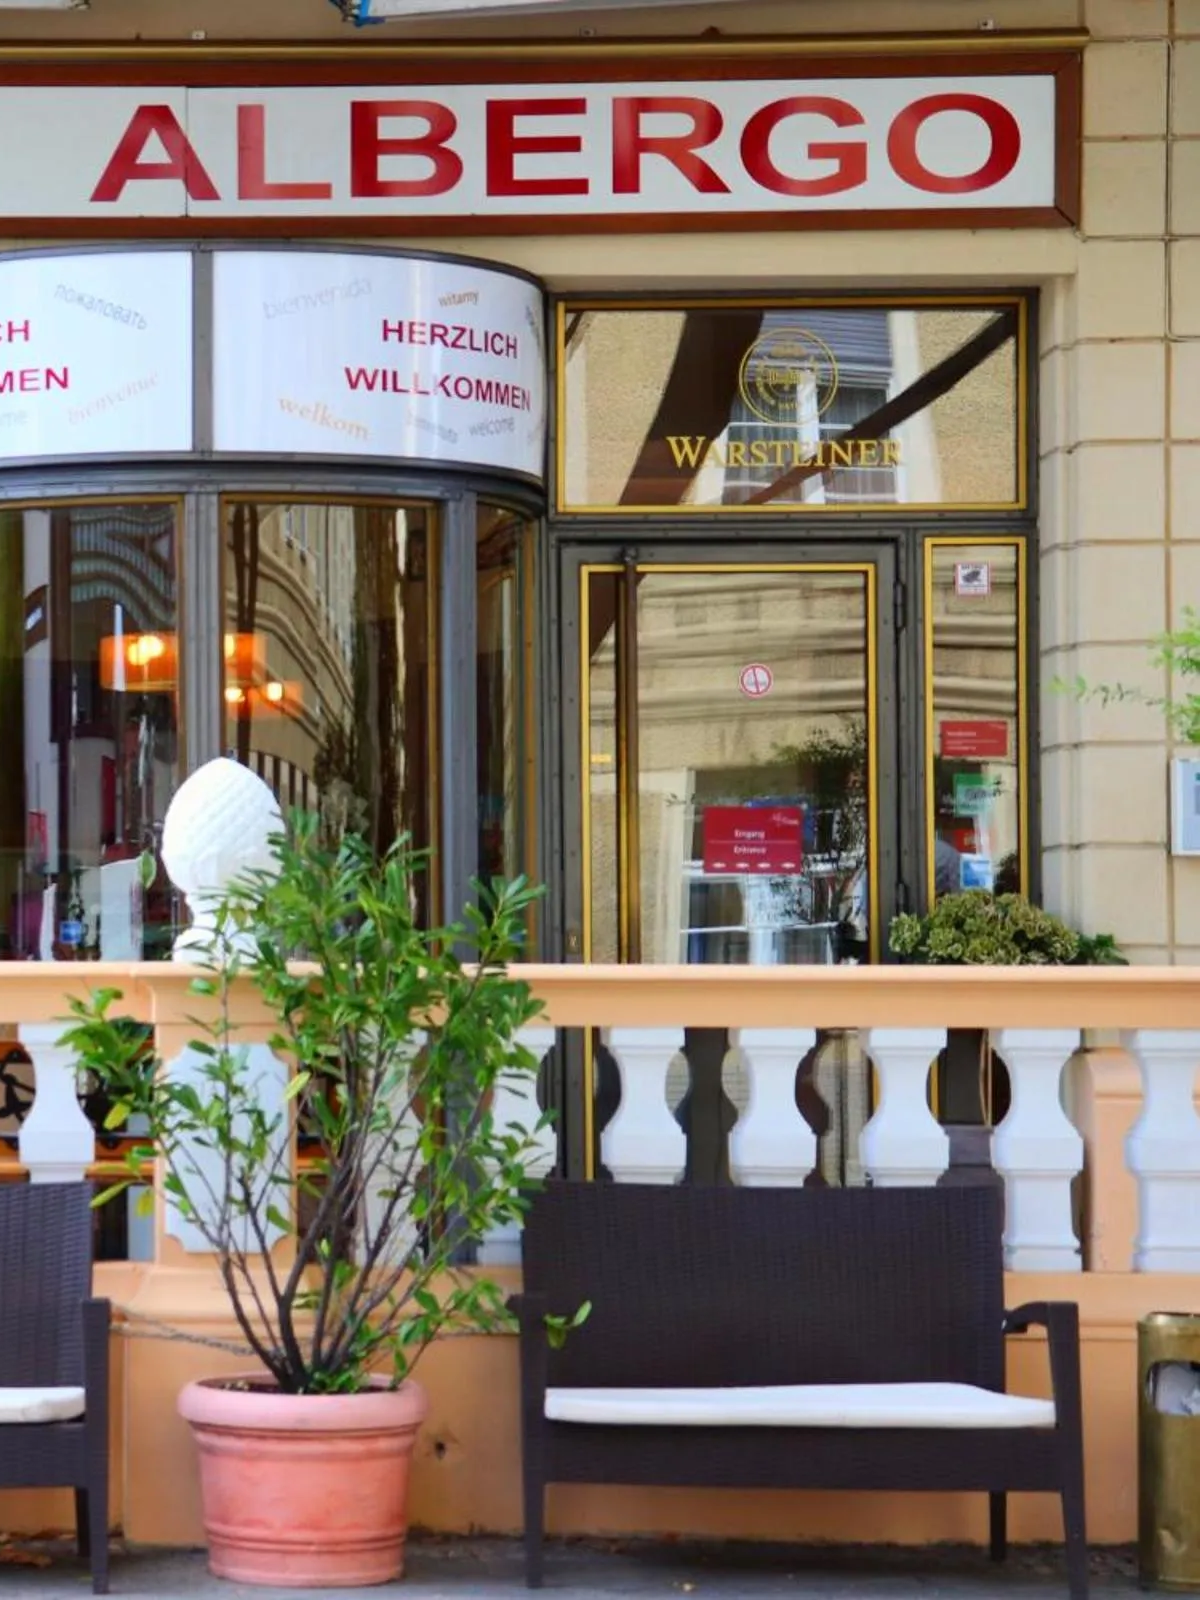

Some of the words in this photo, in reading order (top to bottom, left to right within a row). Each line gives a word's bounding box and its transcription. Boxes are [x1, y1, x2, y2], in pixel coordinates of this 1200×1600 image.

[89, 92, 1022, 202] ALBERGO
[382, 319, 519, 359] HERZLICH
[344, 366, 531, 412] WILLKOMMEN
[666, 435, 905, 469] WARSTEINER
